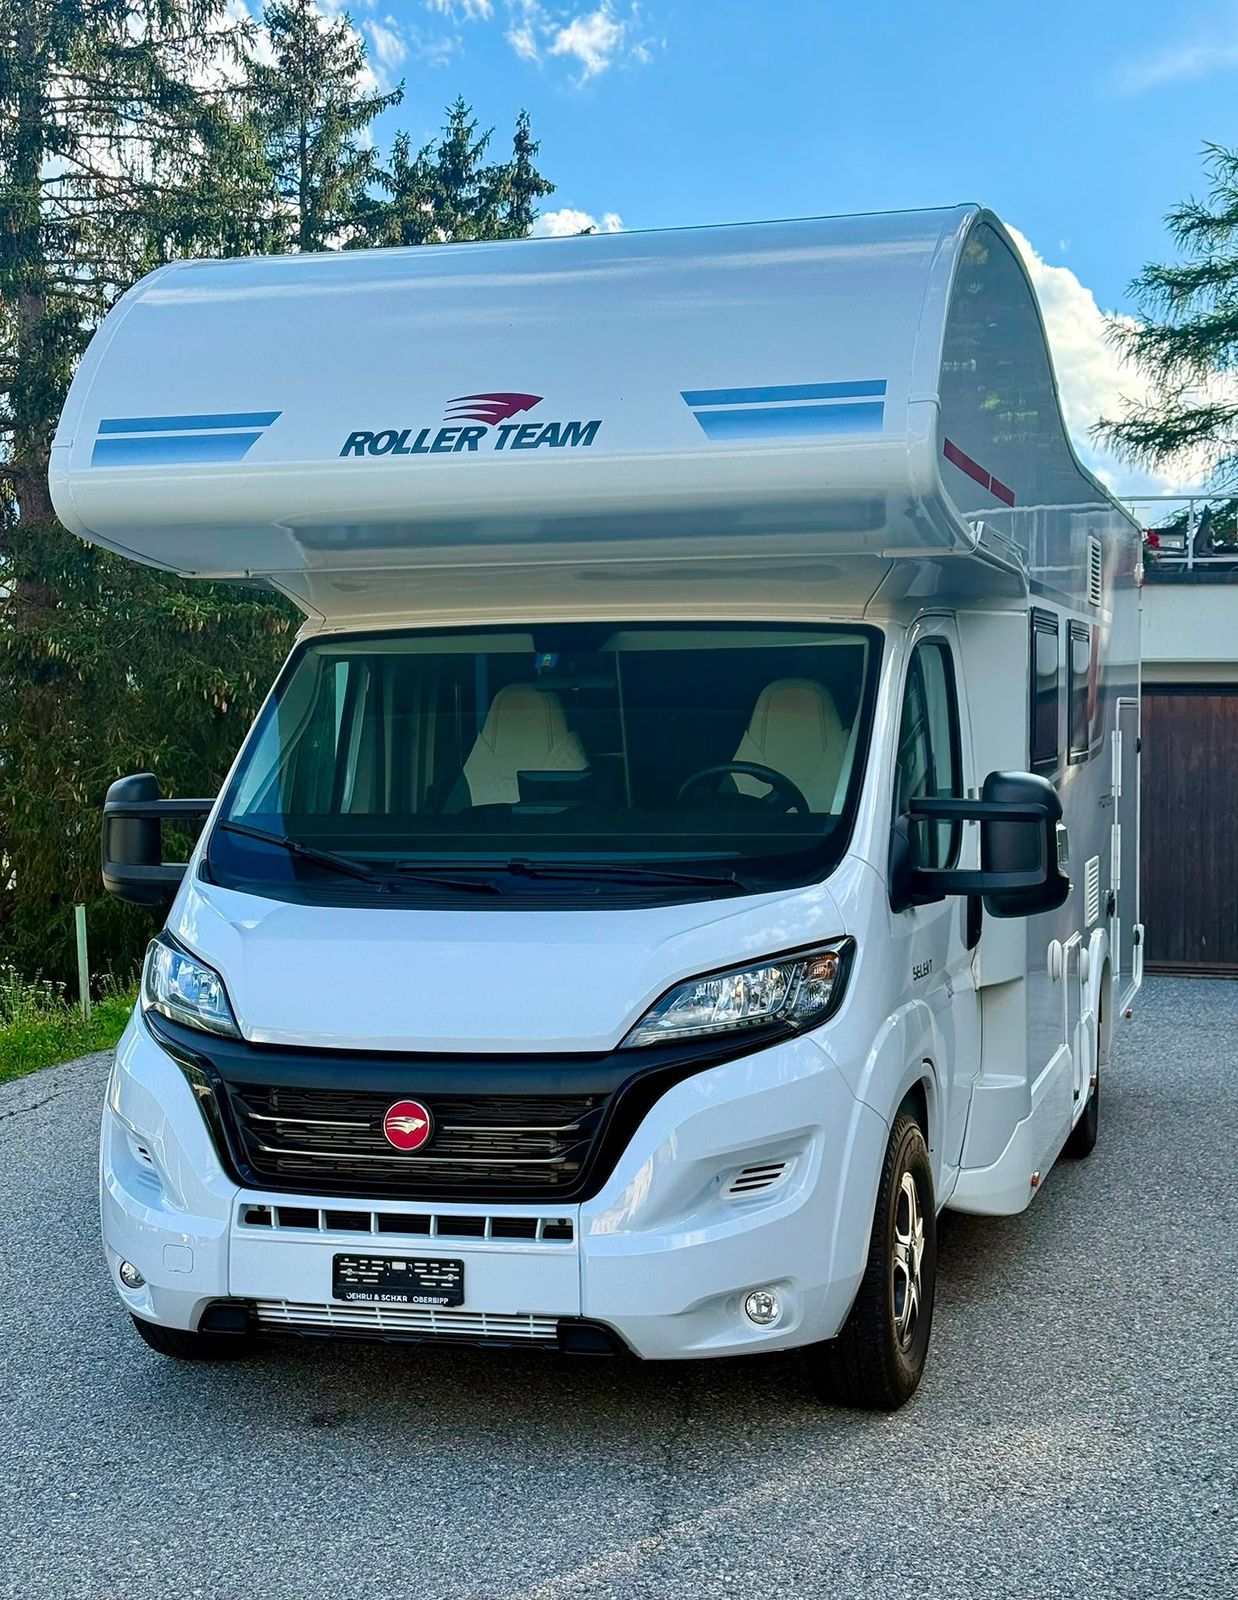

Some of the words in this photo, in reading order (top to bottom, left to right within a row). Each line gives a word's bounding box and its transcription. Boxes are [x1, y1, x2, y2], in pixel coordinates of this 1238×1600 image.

[339, 426, 487, 456] ROLLER
[494, 420, 602, 450] TEAM
[413, 1296, 448, 1305] OBERBIPP
